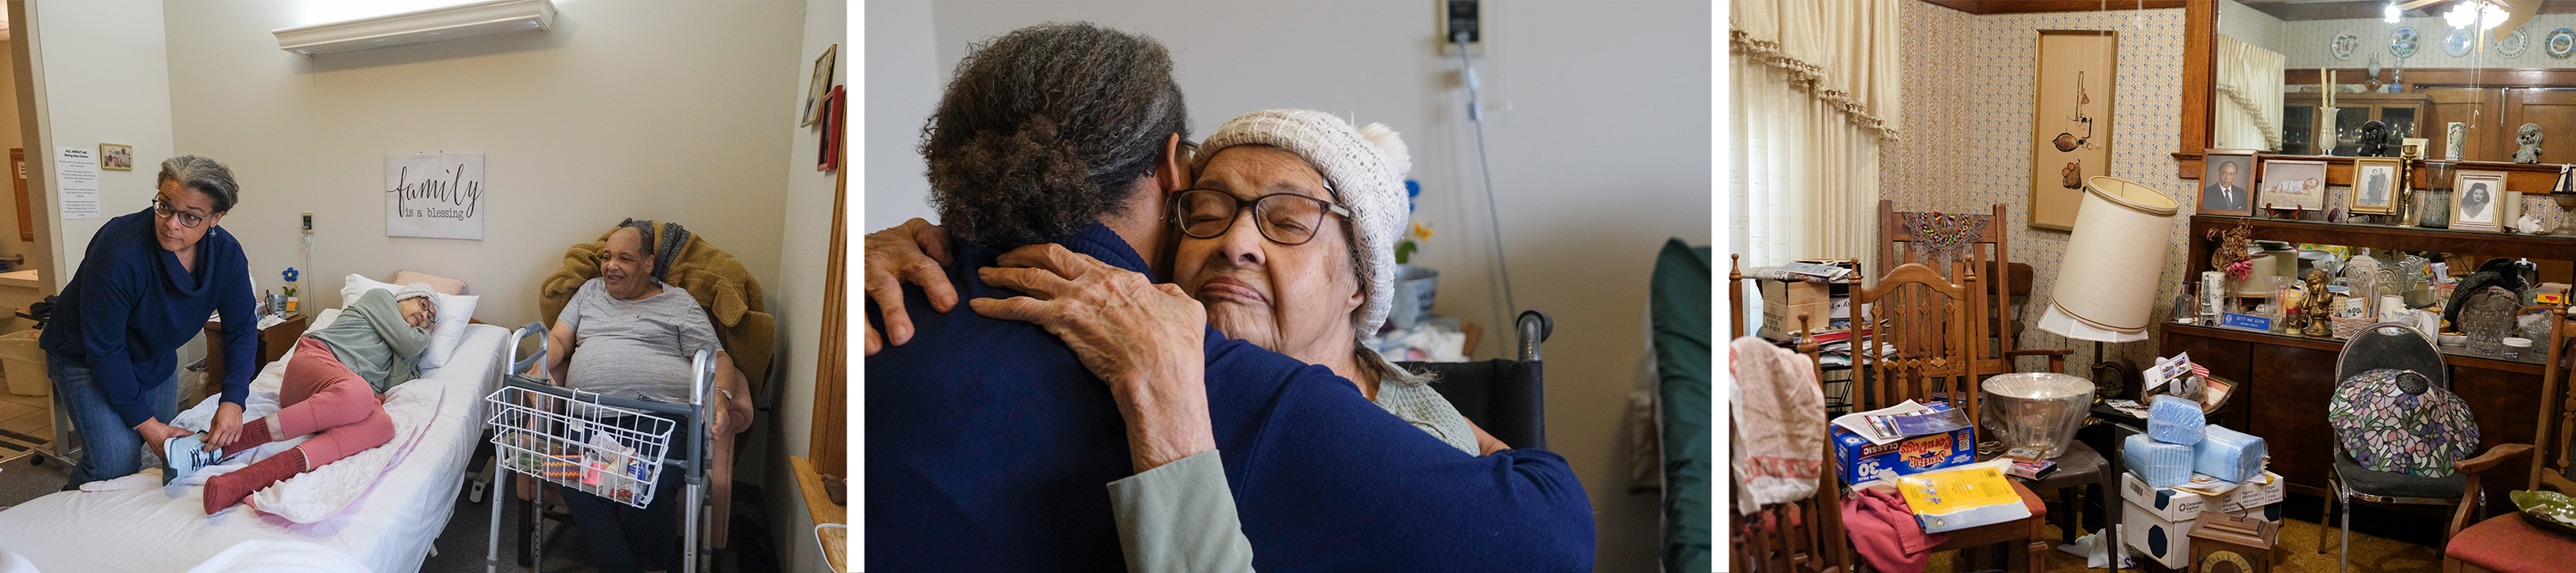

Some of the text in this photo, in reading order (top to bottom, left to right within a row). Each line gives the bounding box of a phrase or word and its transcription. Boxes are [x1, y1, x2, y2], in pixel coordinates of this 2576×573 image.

[387, 164, 483, 218] family
[405, 208, 413, 217] is
[427, 207, 464, 221] blessing
[1863, 442, 1899, 455] CLASSIC
[1909, 455, 1926, 468] FAIR
[1926, 450, 1946, 466] STATE
[1858, 462, 1880, 477] 30
